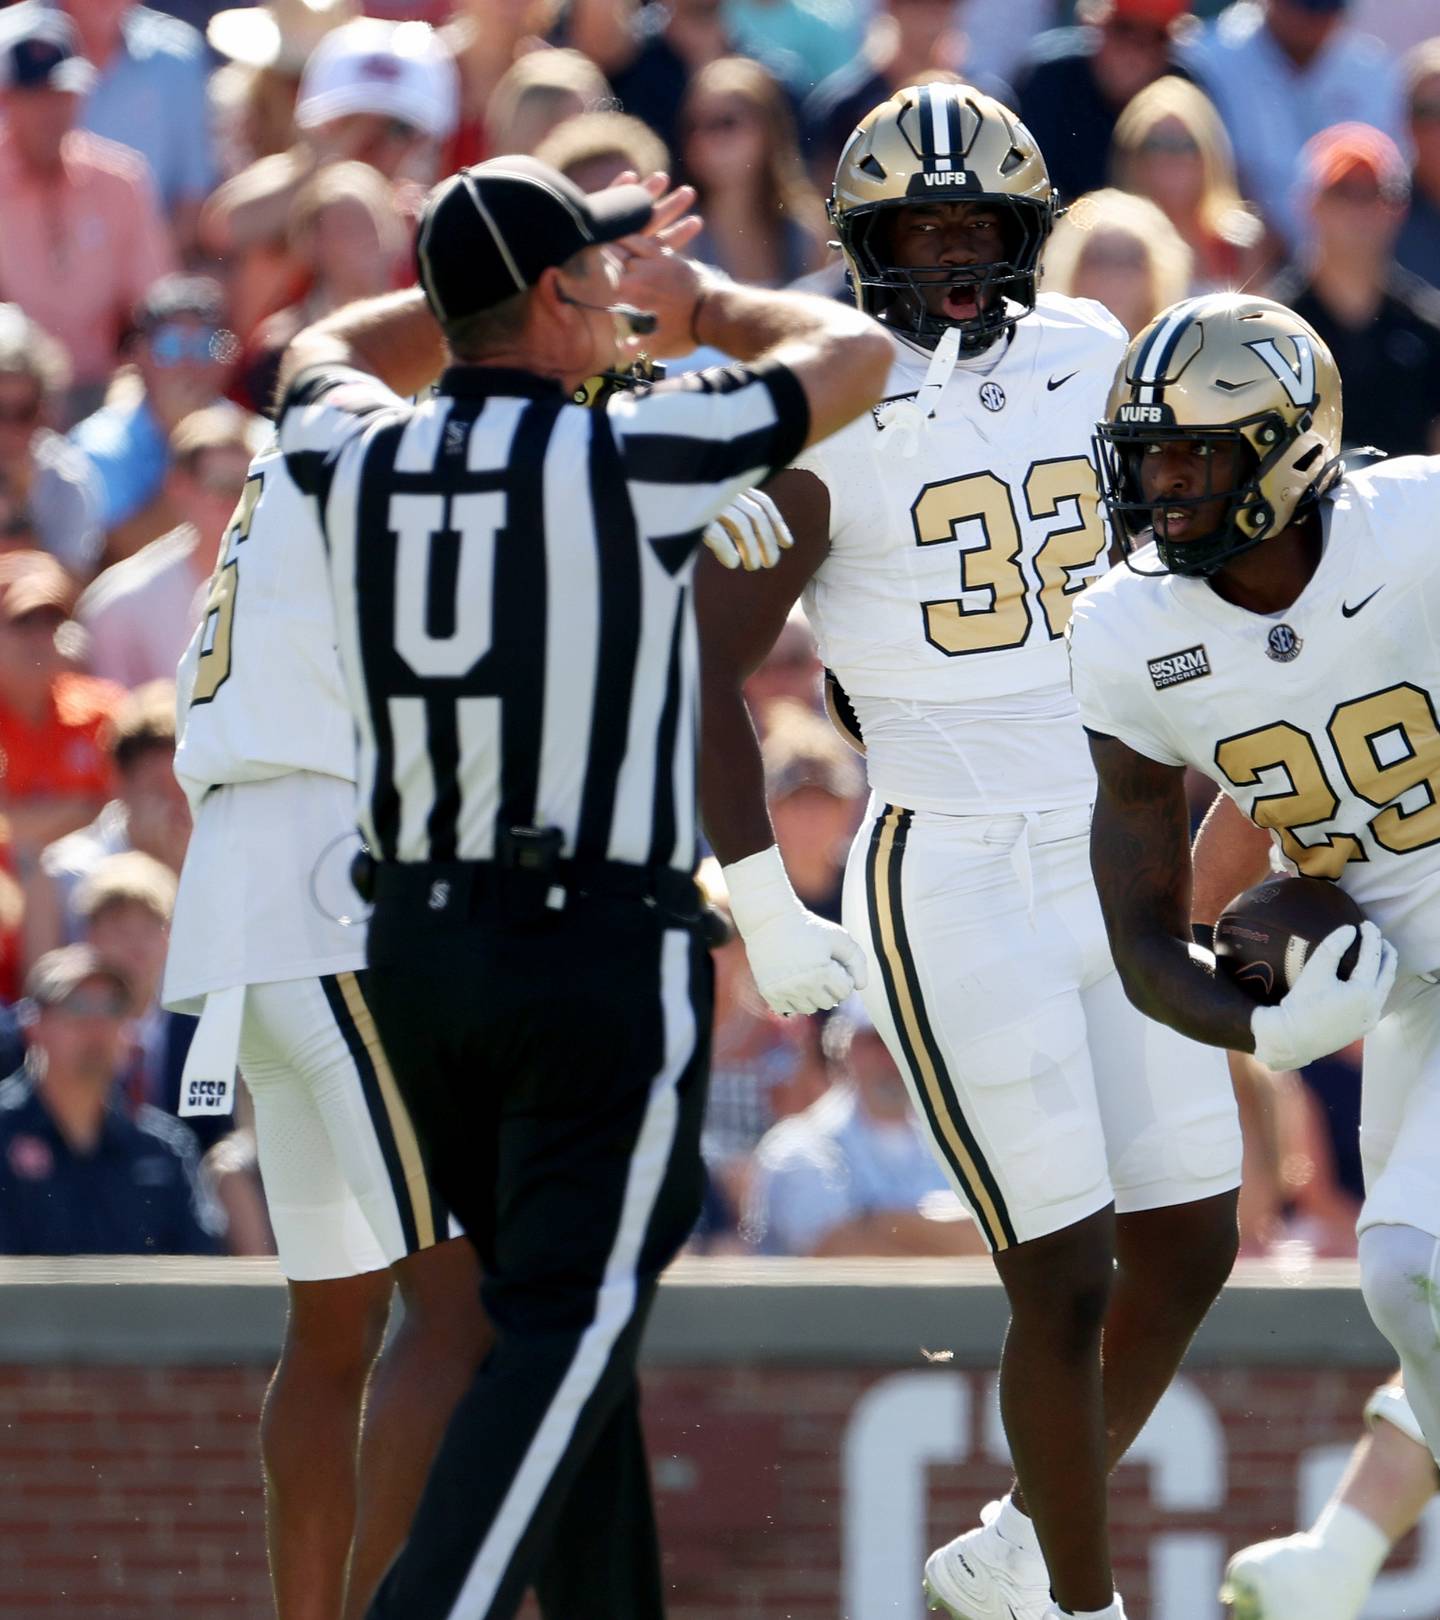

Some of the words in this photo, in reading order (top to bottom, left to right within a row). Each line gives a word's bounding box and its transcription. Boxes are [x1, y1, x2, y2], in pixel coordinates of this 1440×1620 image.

[922, 172, 967, 187] VUFB
[1242, 335, 1316, 408] V
[980, 383, 1005, 412] SEC
[1120, 406, 1162, 423] VUFB
[910, 454, 1107, 658] 32
[388, 491, 506, 678] U
[1270, 626, 1295, 653] SEC
[1155, 665, 1209, 687] CONCRETE
[1160, 649, 1208, 678] SRM
